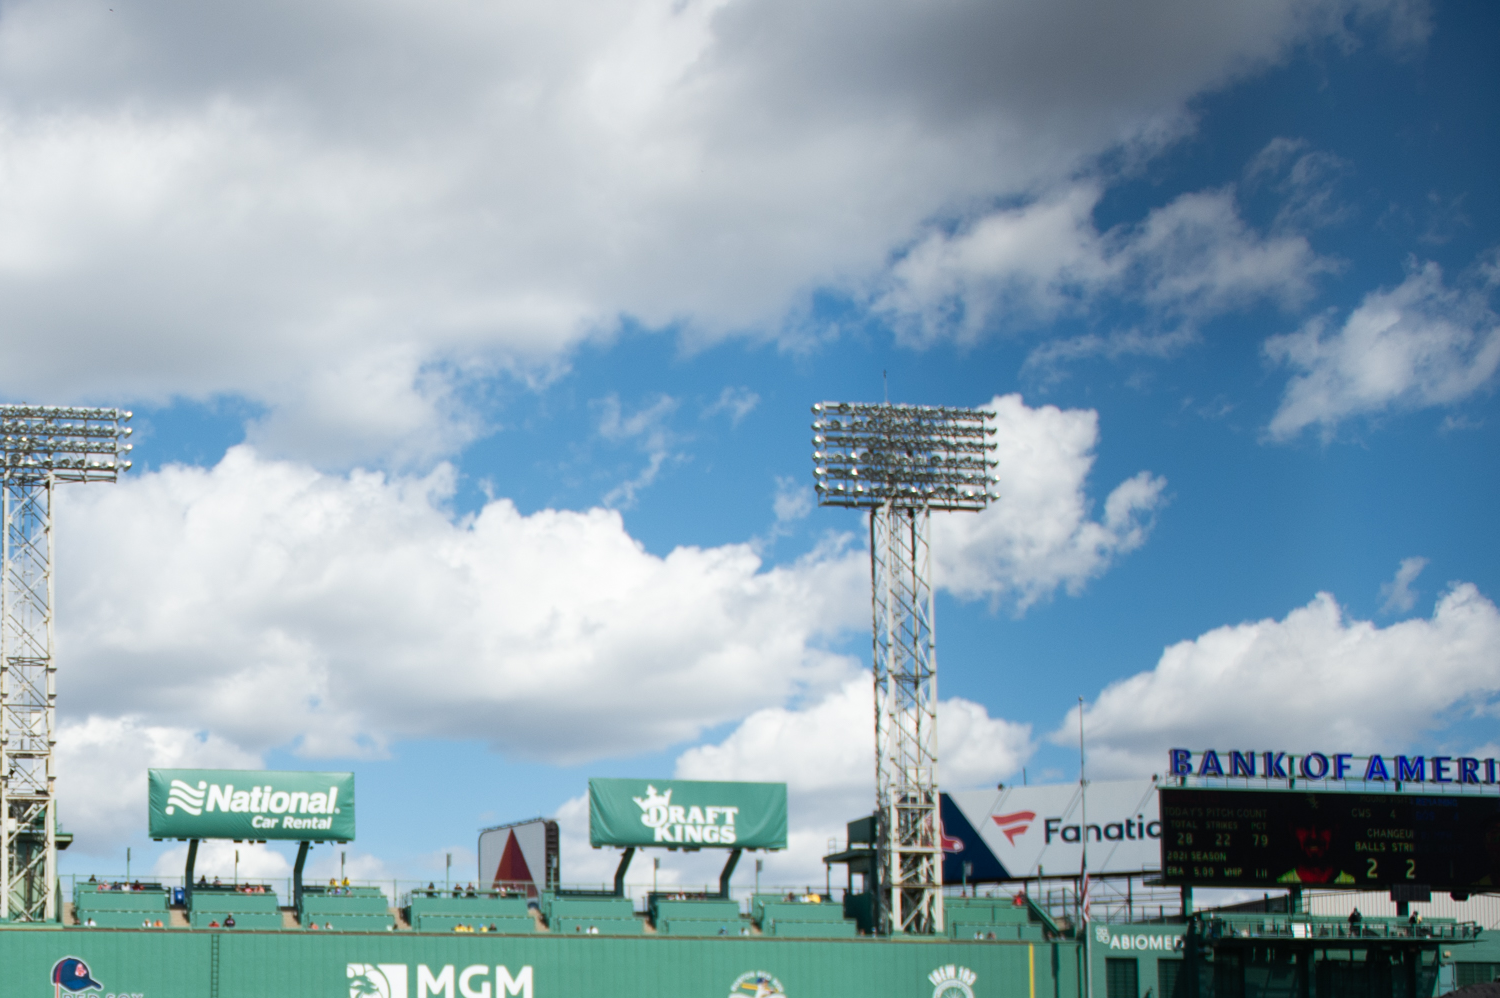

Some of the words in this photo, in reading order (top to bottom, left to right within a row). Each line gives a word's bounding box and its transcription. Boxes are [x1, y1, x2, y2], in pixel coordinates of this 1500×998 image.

[1168, 747, 1287, 780] BANK
[1299, 751, 1353, 781] OF
[641, 805, 739, 828] DRAFT
[1164, 807, 1203, 817] TODAY'S
[1206, 807, 1234, 818] PITCH
[1237, 808, 1267, 819] COUNT
[1351, 808, 1371, 818] CWS
[251, 815, 279, 829] Car
[282, 816, 333, 830] Rental
[1170, 820, 1198, 829] TOTAL
[1205, 821, 1238, 830] STRIKES
[1251, 822, 1267, 831] PCT
[654, 825, 737, 844] KINGS
[1177, 832, 1194, 846] 28
[1215, 833, 1231, 847] 22
[1252, 834, 1269, 848] 79
[1355, 841, 1386, 852] BALLS
[1166, 850, 1188, 861] 2021
[1190, 851, 1227, 862] SEASON
[1166, 866, 1185, 876] ERA
[1193, 866, 1214, 877] 5.00
[1224, 867, 1243, 877] WHIP
[1366, 858, 1378, 879] 2
[1405, 858, 1416, 880] 2
